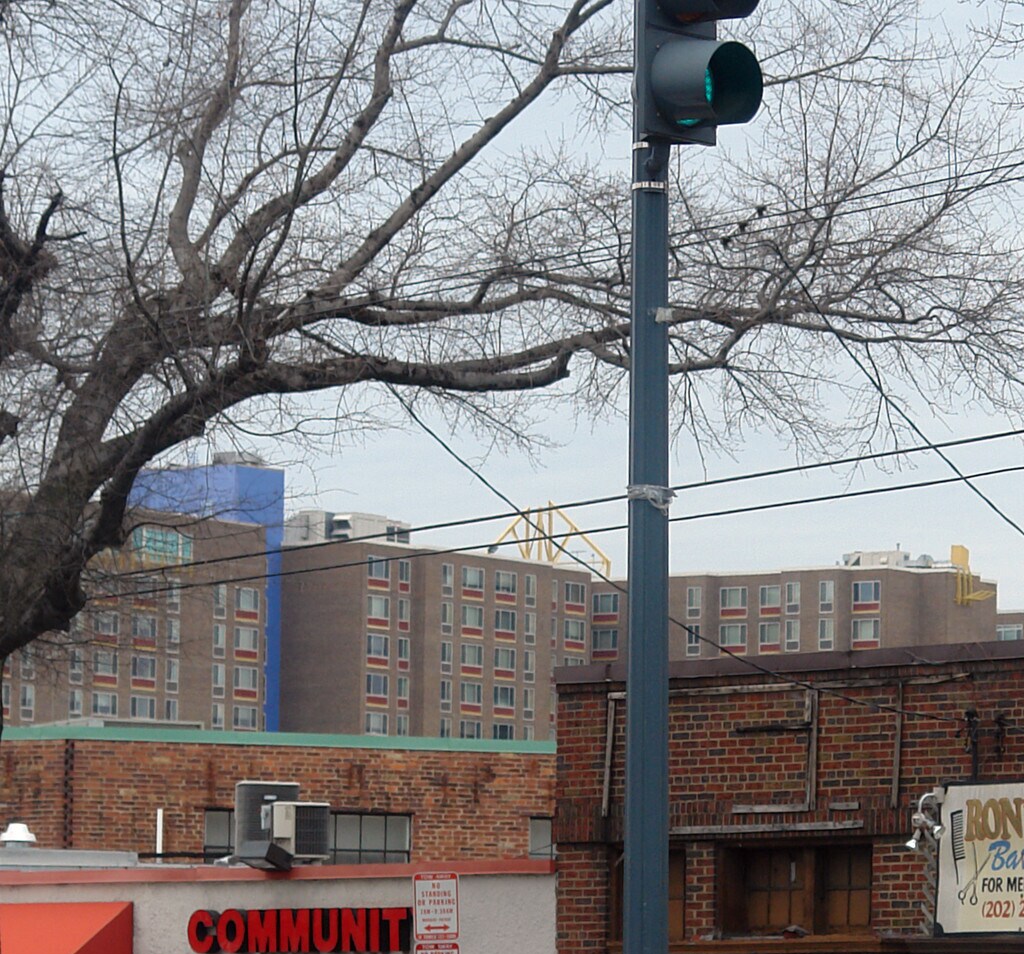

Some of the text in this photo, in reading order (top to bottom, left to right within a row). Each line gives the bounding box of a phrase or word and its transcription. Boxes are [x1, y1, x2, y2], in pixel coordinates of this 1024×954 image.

[981, 876, 1003, 893] FOR
[981, 899, 1015, 918] (202)
[187, 907, 413, 954] COMMUNIT
